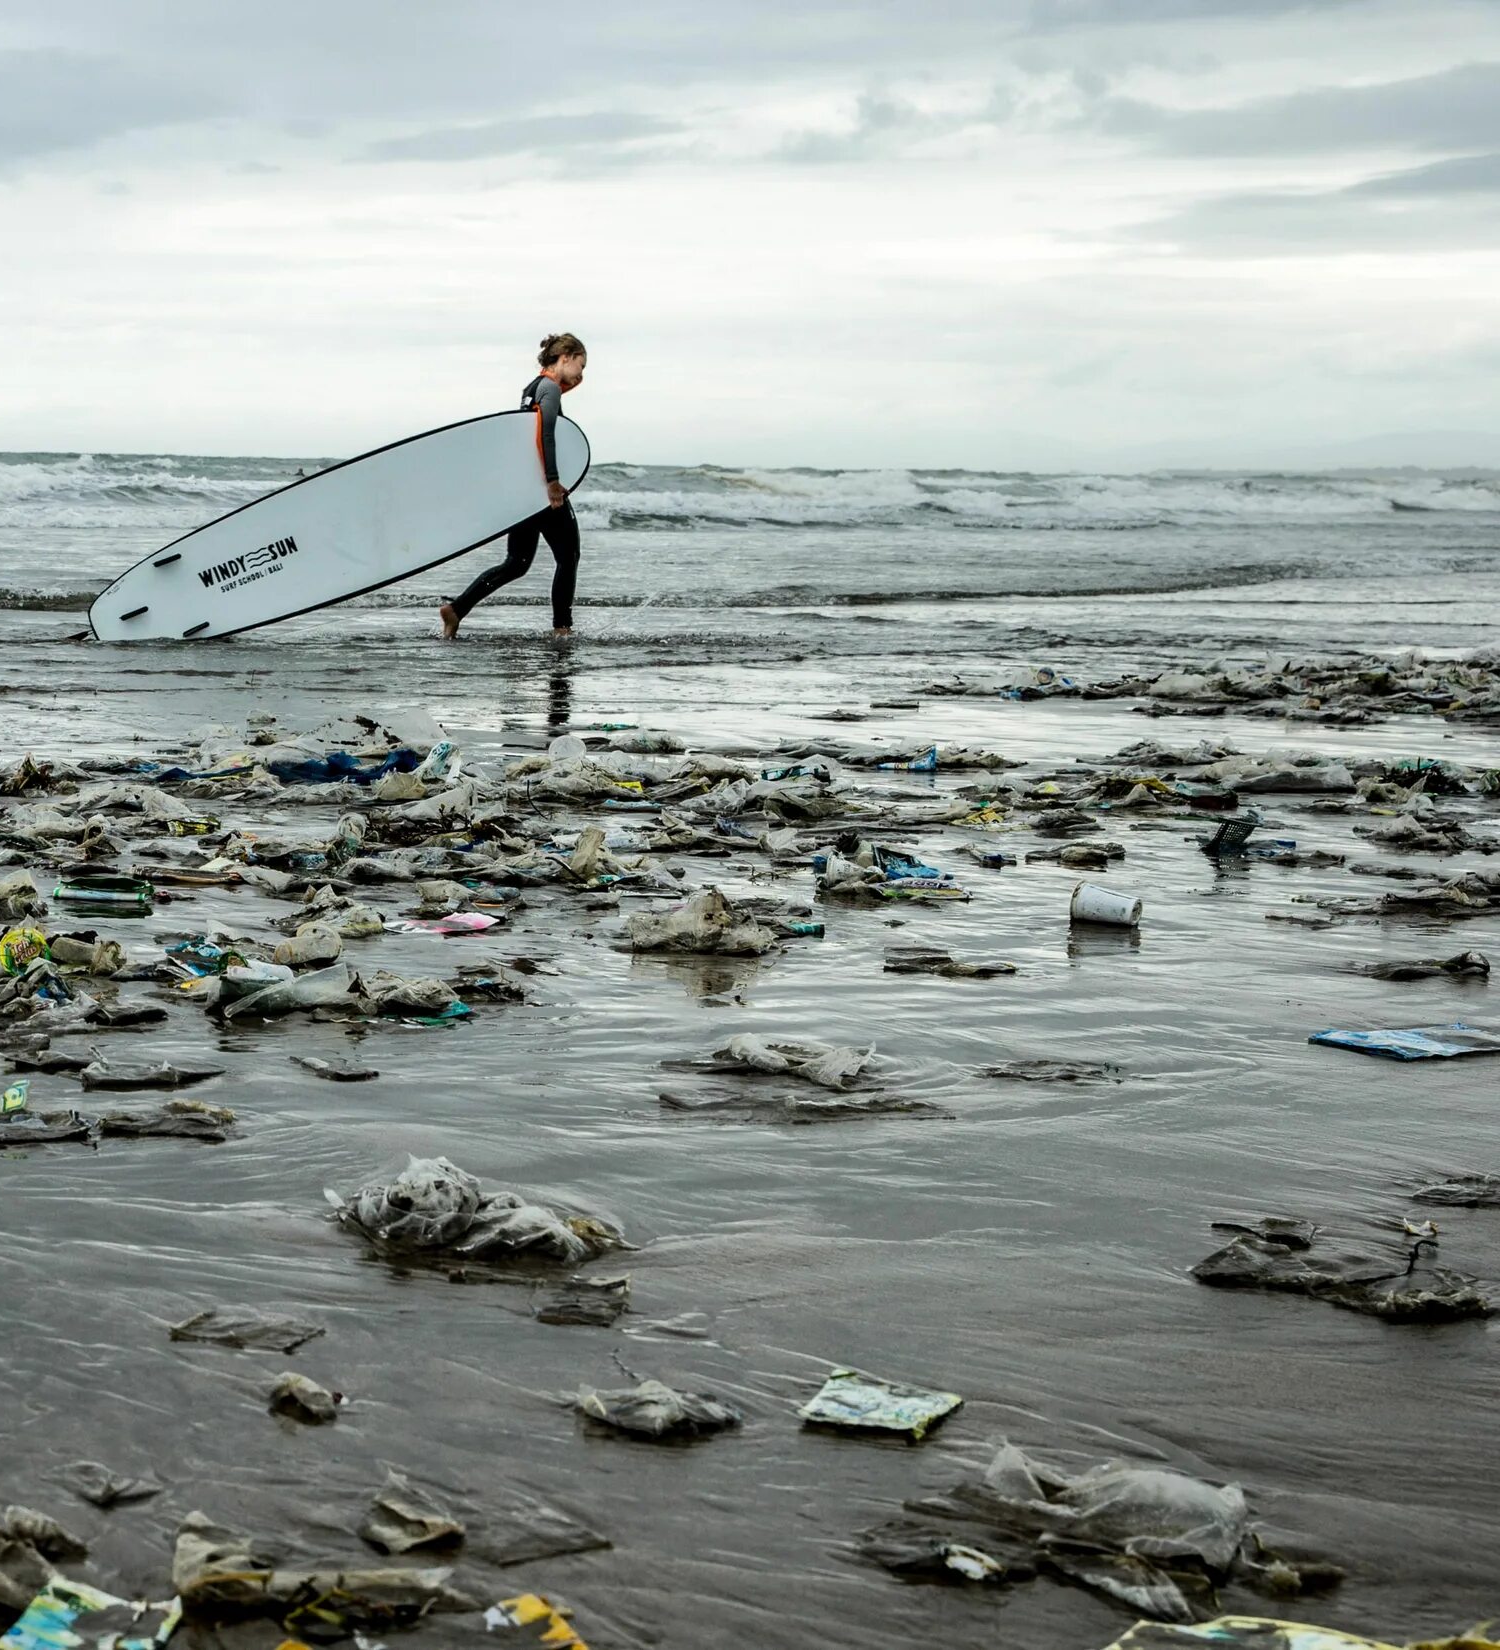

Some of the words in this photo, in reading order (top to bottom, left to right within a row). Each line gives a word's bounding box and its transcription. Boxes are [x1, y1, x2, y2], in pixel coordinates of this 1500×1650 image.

[198, 555, 246, 588] WINDY
[267, 536, 298, 560] SUN
[220, 581, 237, 593] SURF
[238, 570, 265, 586] SCHOOL
[268, 563, 284, 574] BALI
